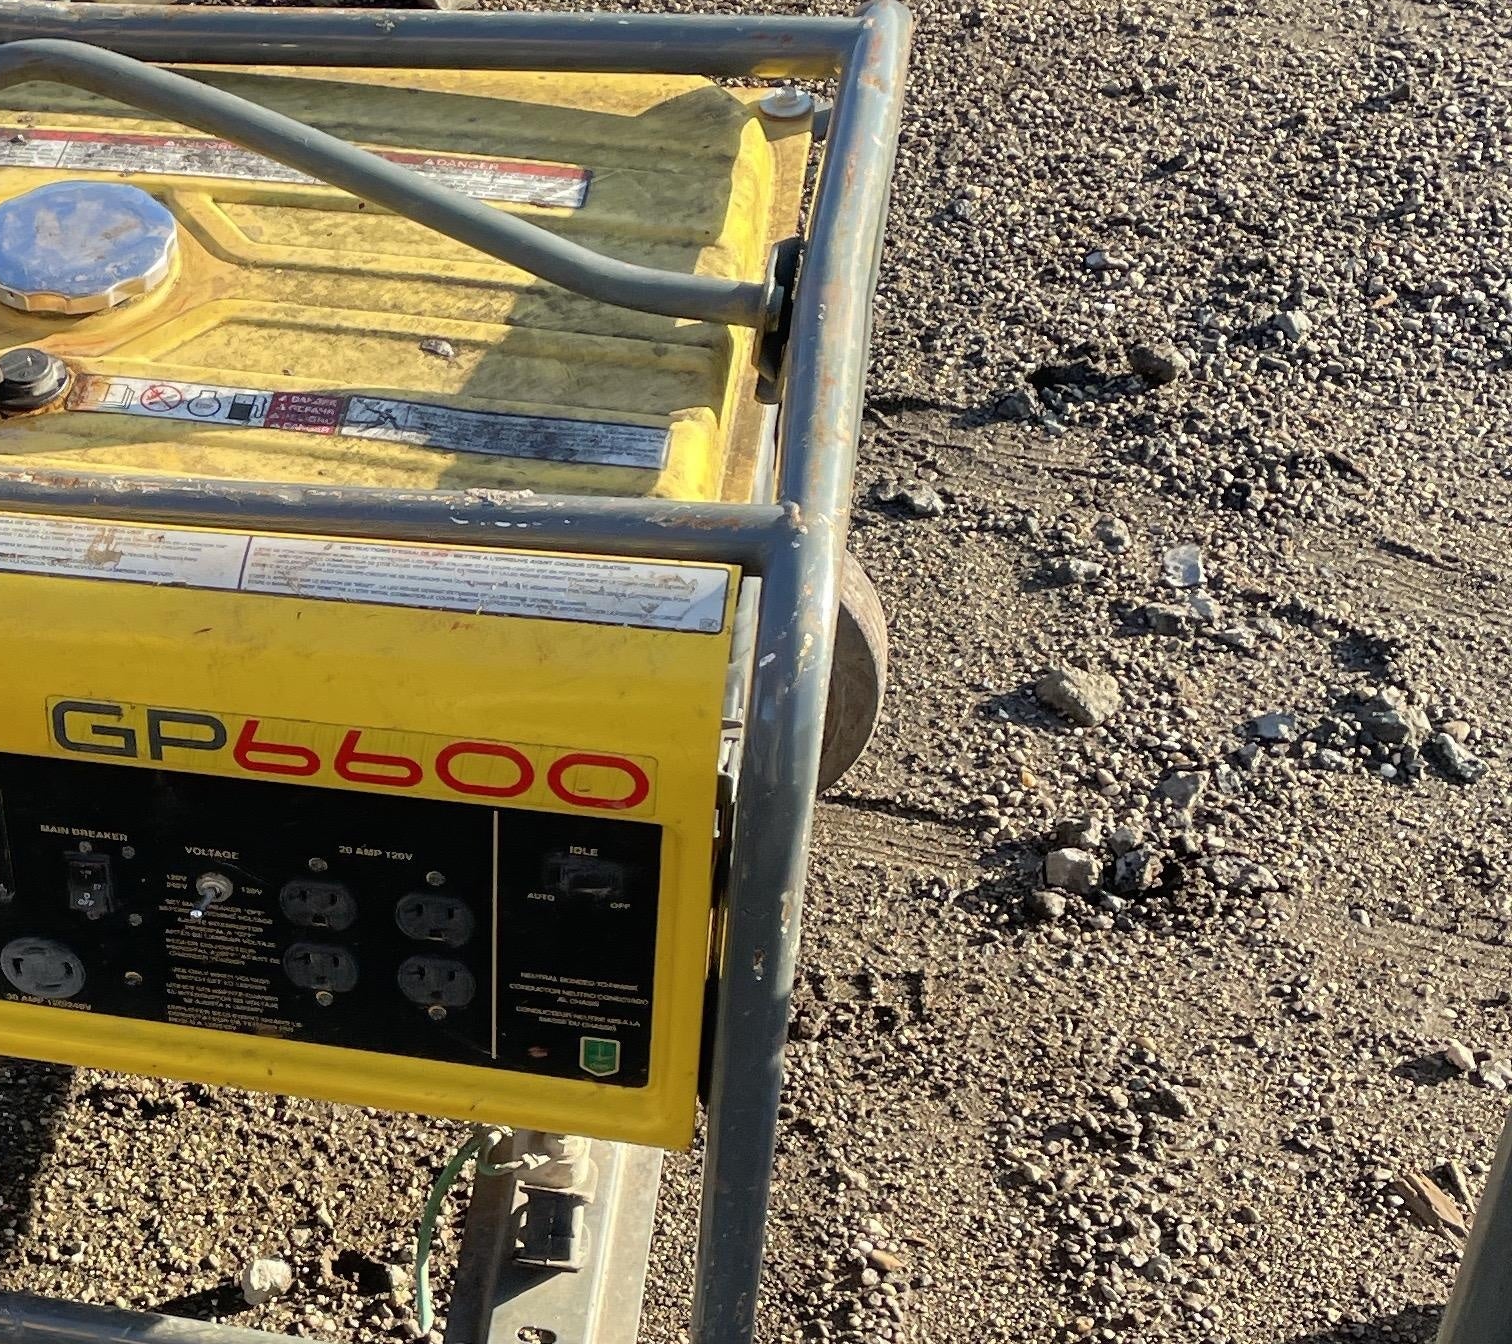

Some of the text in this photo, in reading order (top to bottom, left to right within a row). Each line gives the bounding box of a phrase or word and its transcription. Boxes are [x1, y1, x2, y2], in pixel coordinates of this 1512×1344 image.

[436, 158, 500, 172] DANGER
[52, 699, 649, 808] GP6600
[39, 824, 129, 842] MAIN BREAKER
[184, 845, 240, 860] VOLTAGE
[338, 845, 414, 862] 20 AMP 120V
[569, 845, 599, 857] IDLE
[527, 892, 556, 902] AUTO
[609, 902, 632, 910] OFF
